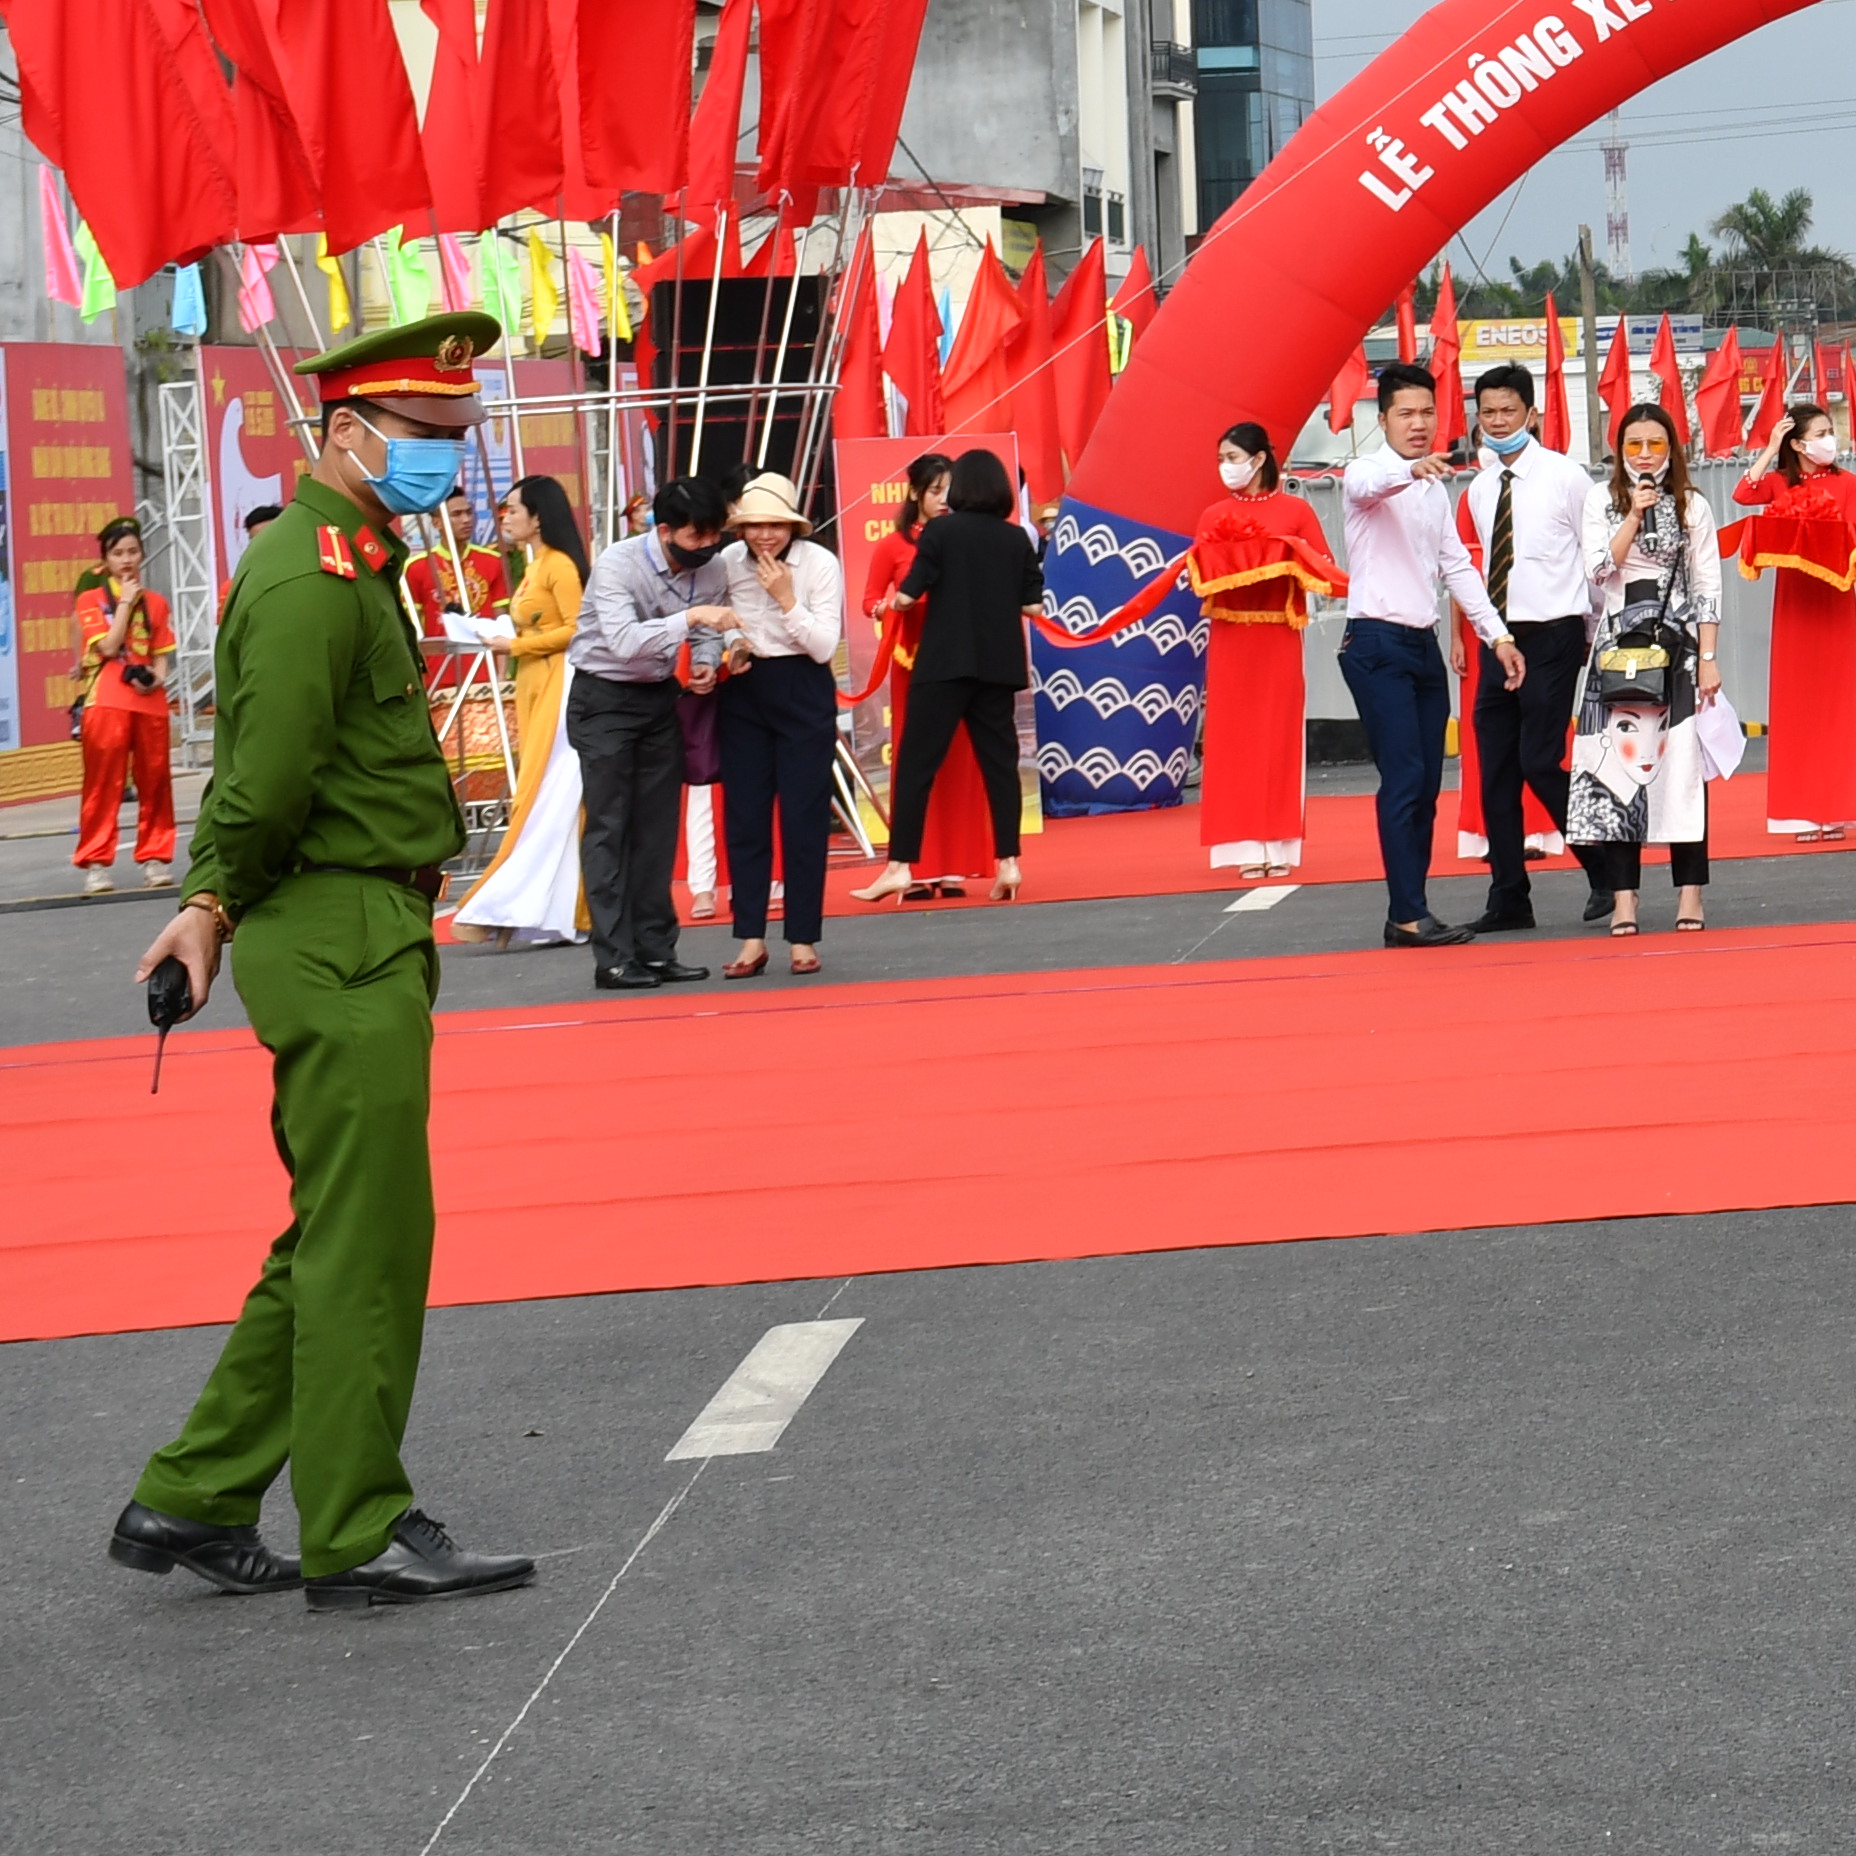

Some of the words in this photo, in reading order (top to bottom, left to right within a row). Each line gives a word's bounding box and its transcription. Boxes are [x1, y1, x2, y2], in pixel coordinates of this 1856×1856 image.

[1358, 125, 1435, 212] LỄ
[1419, 15, 1584, 151] THÔNG
[1476, 324, 1547, 347] ENEOS
